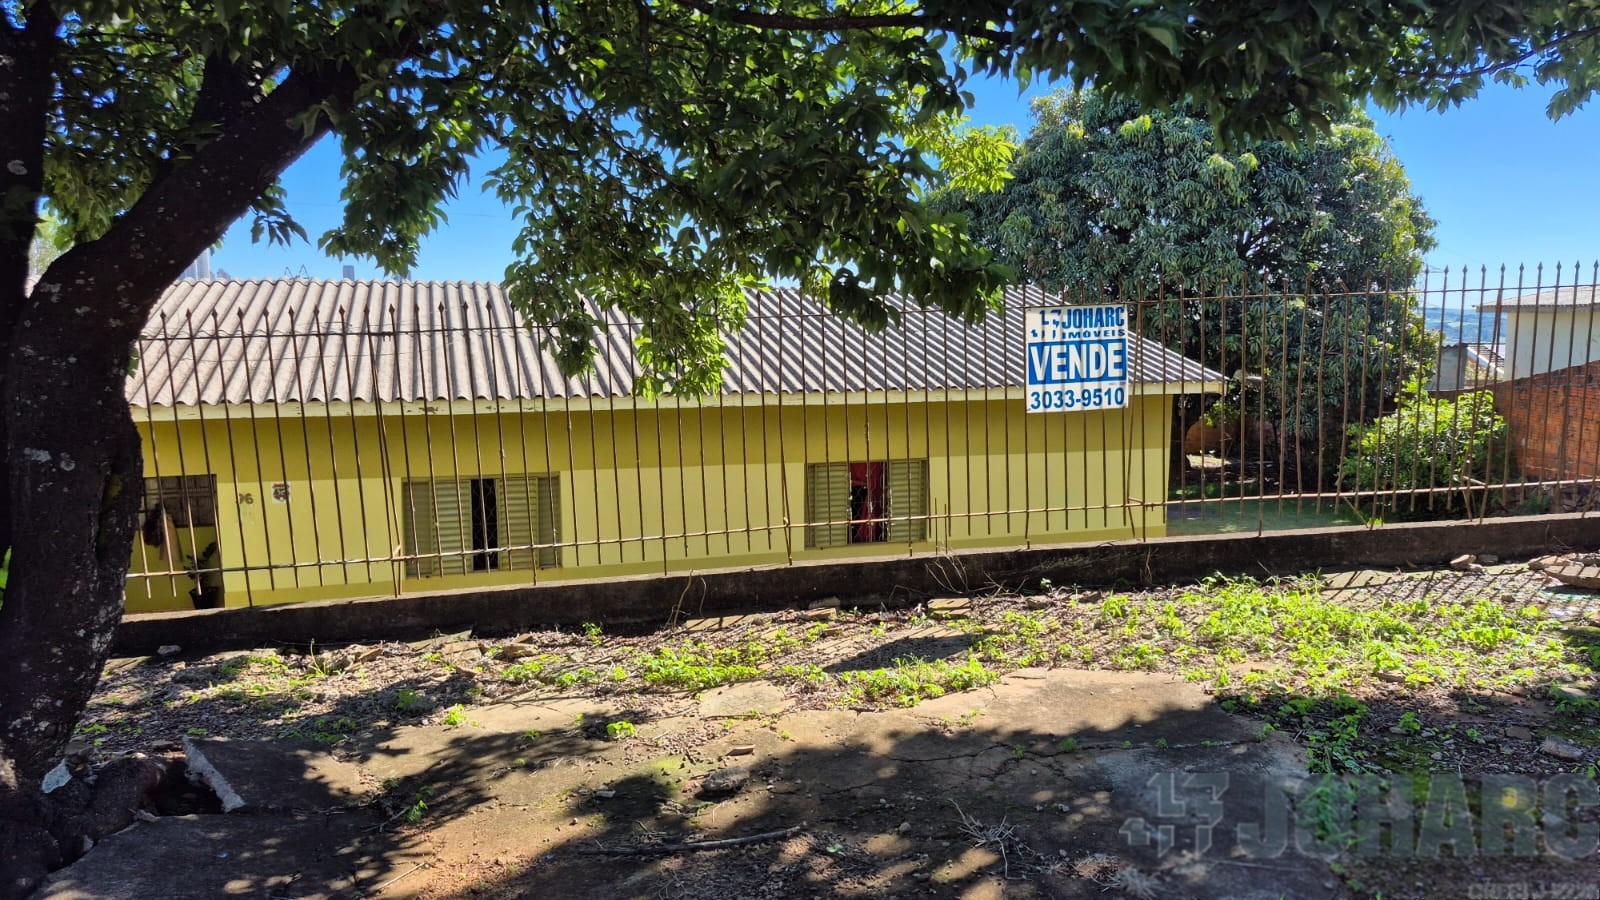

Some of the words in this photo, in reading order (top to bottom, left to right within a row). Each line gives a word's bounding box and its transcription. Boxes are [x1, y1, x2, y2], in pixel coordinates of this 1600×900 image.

[1061, 306, 1125, 329] JOHARC
[1030, 342, 1123, 382] VENDE
[1030, 387, 1125, 410] 3033-9510
